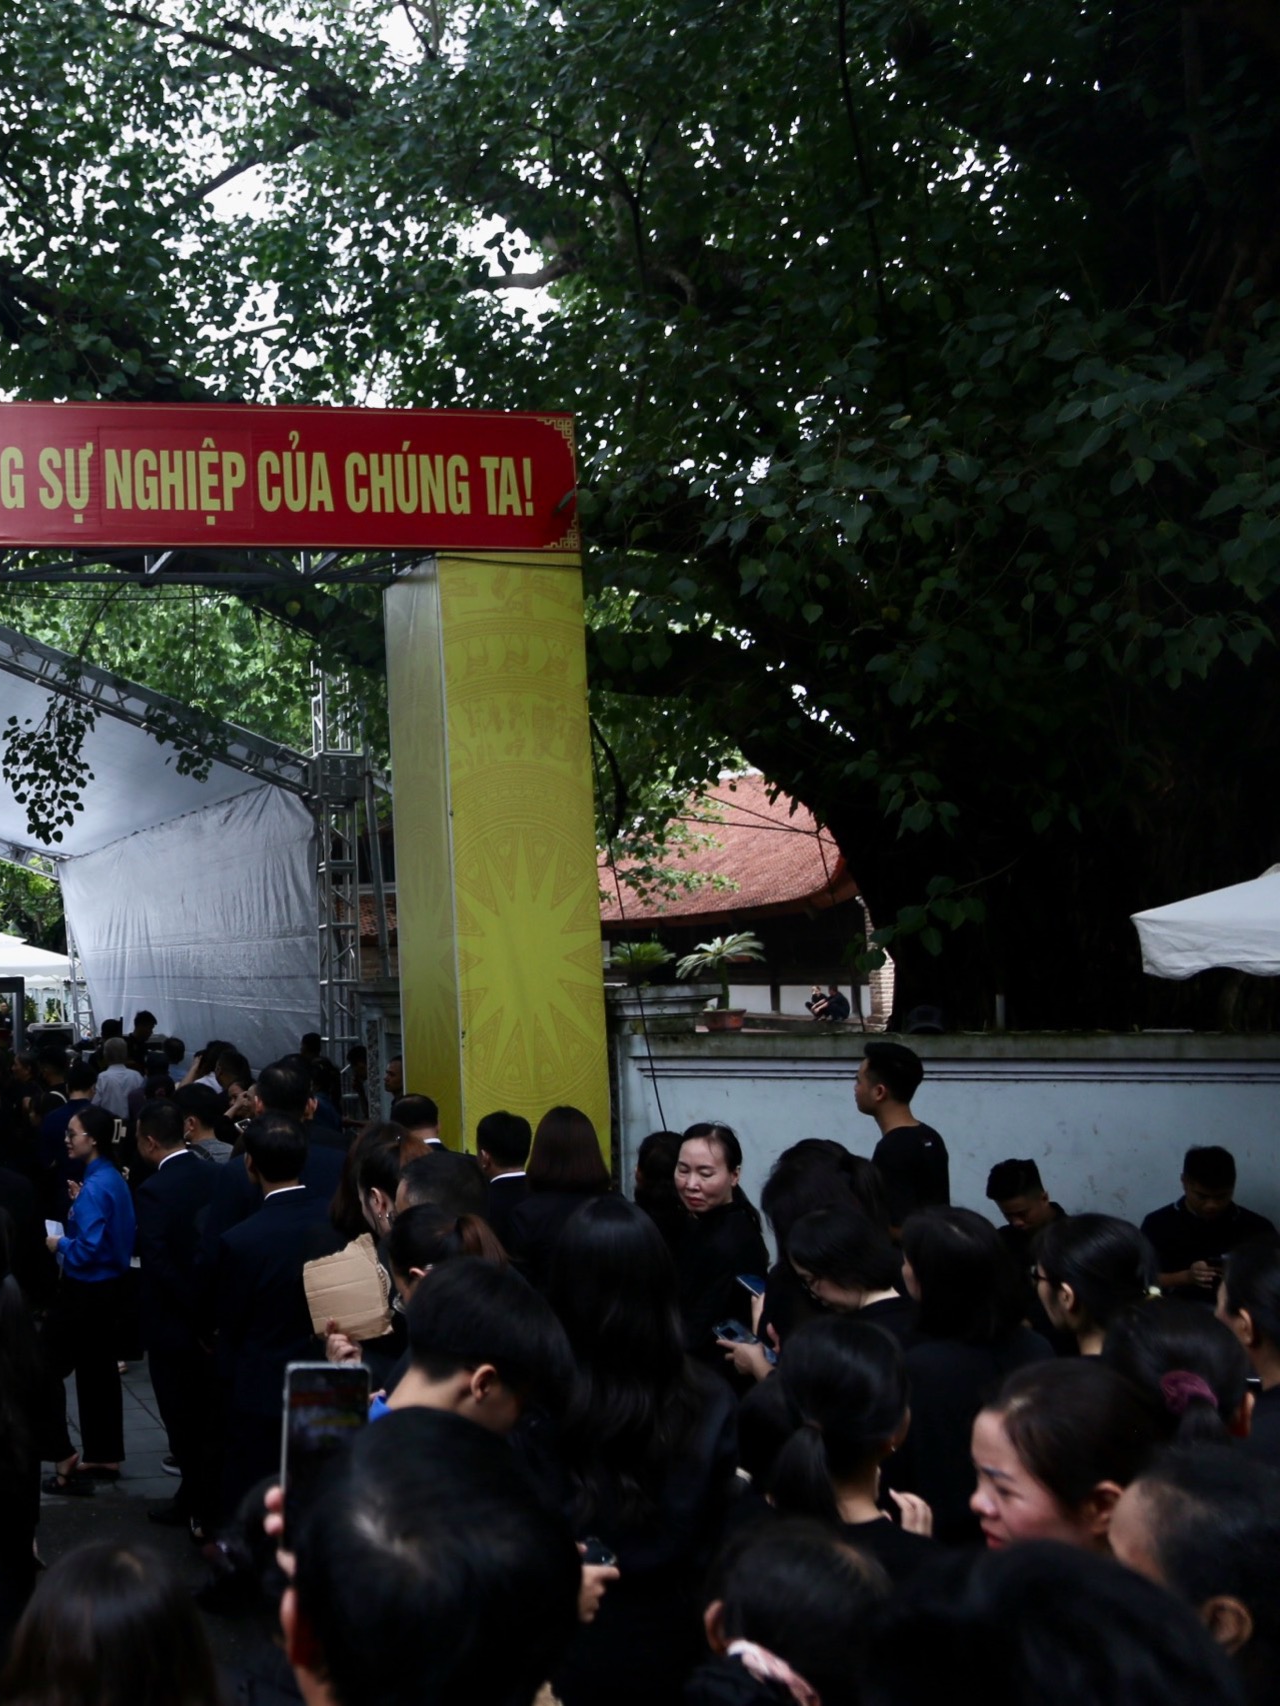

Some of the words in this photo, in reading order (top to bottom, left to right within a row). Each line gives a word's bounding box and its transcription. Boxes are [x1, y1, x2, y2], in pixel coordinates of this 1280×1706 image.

[38, 441, 94, 524] SỰ
[104, 437, 246, 526] NGHIỆP
[257, 431, 334, 512] CỦA
[345, 441, 471, 515] CHÚNG
[480, 456, 535, 517] TA!
